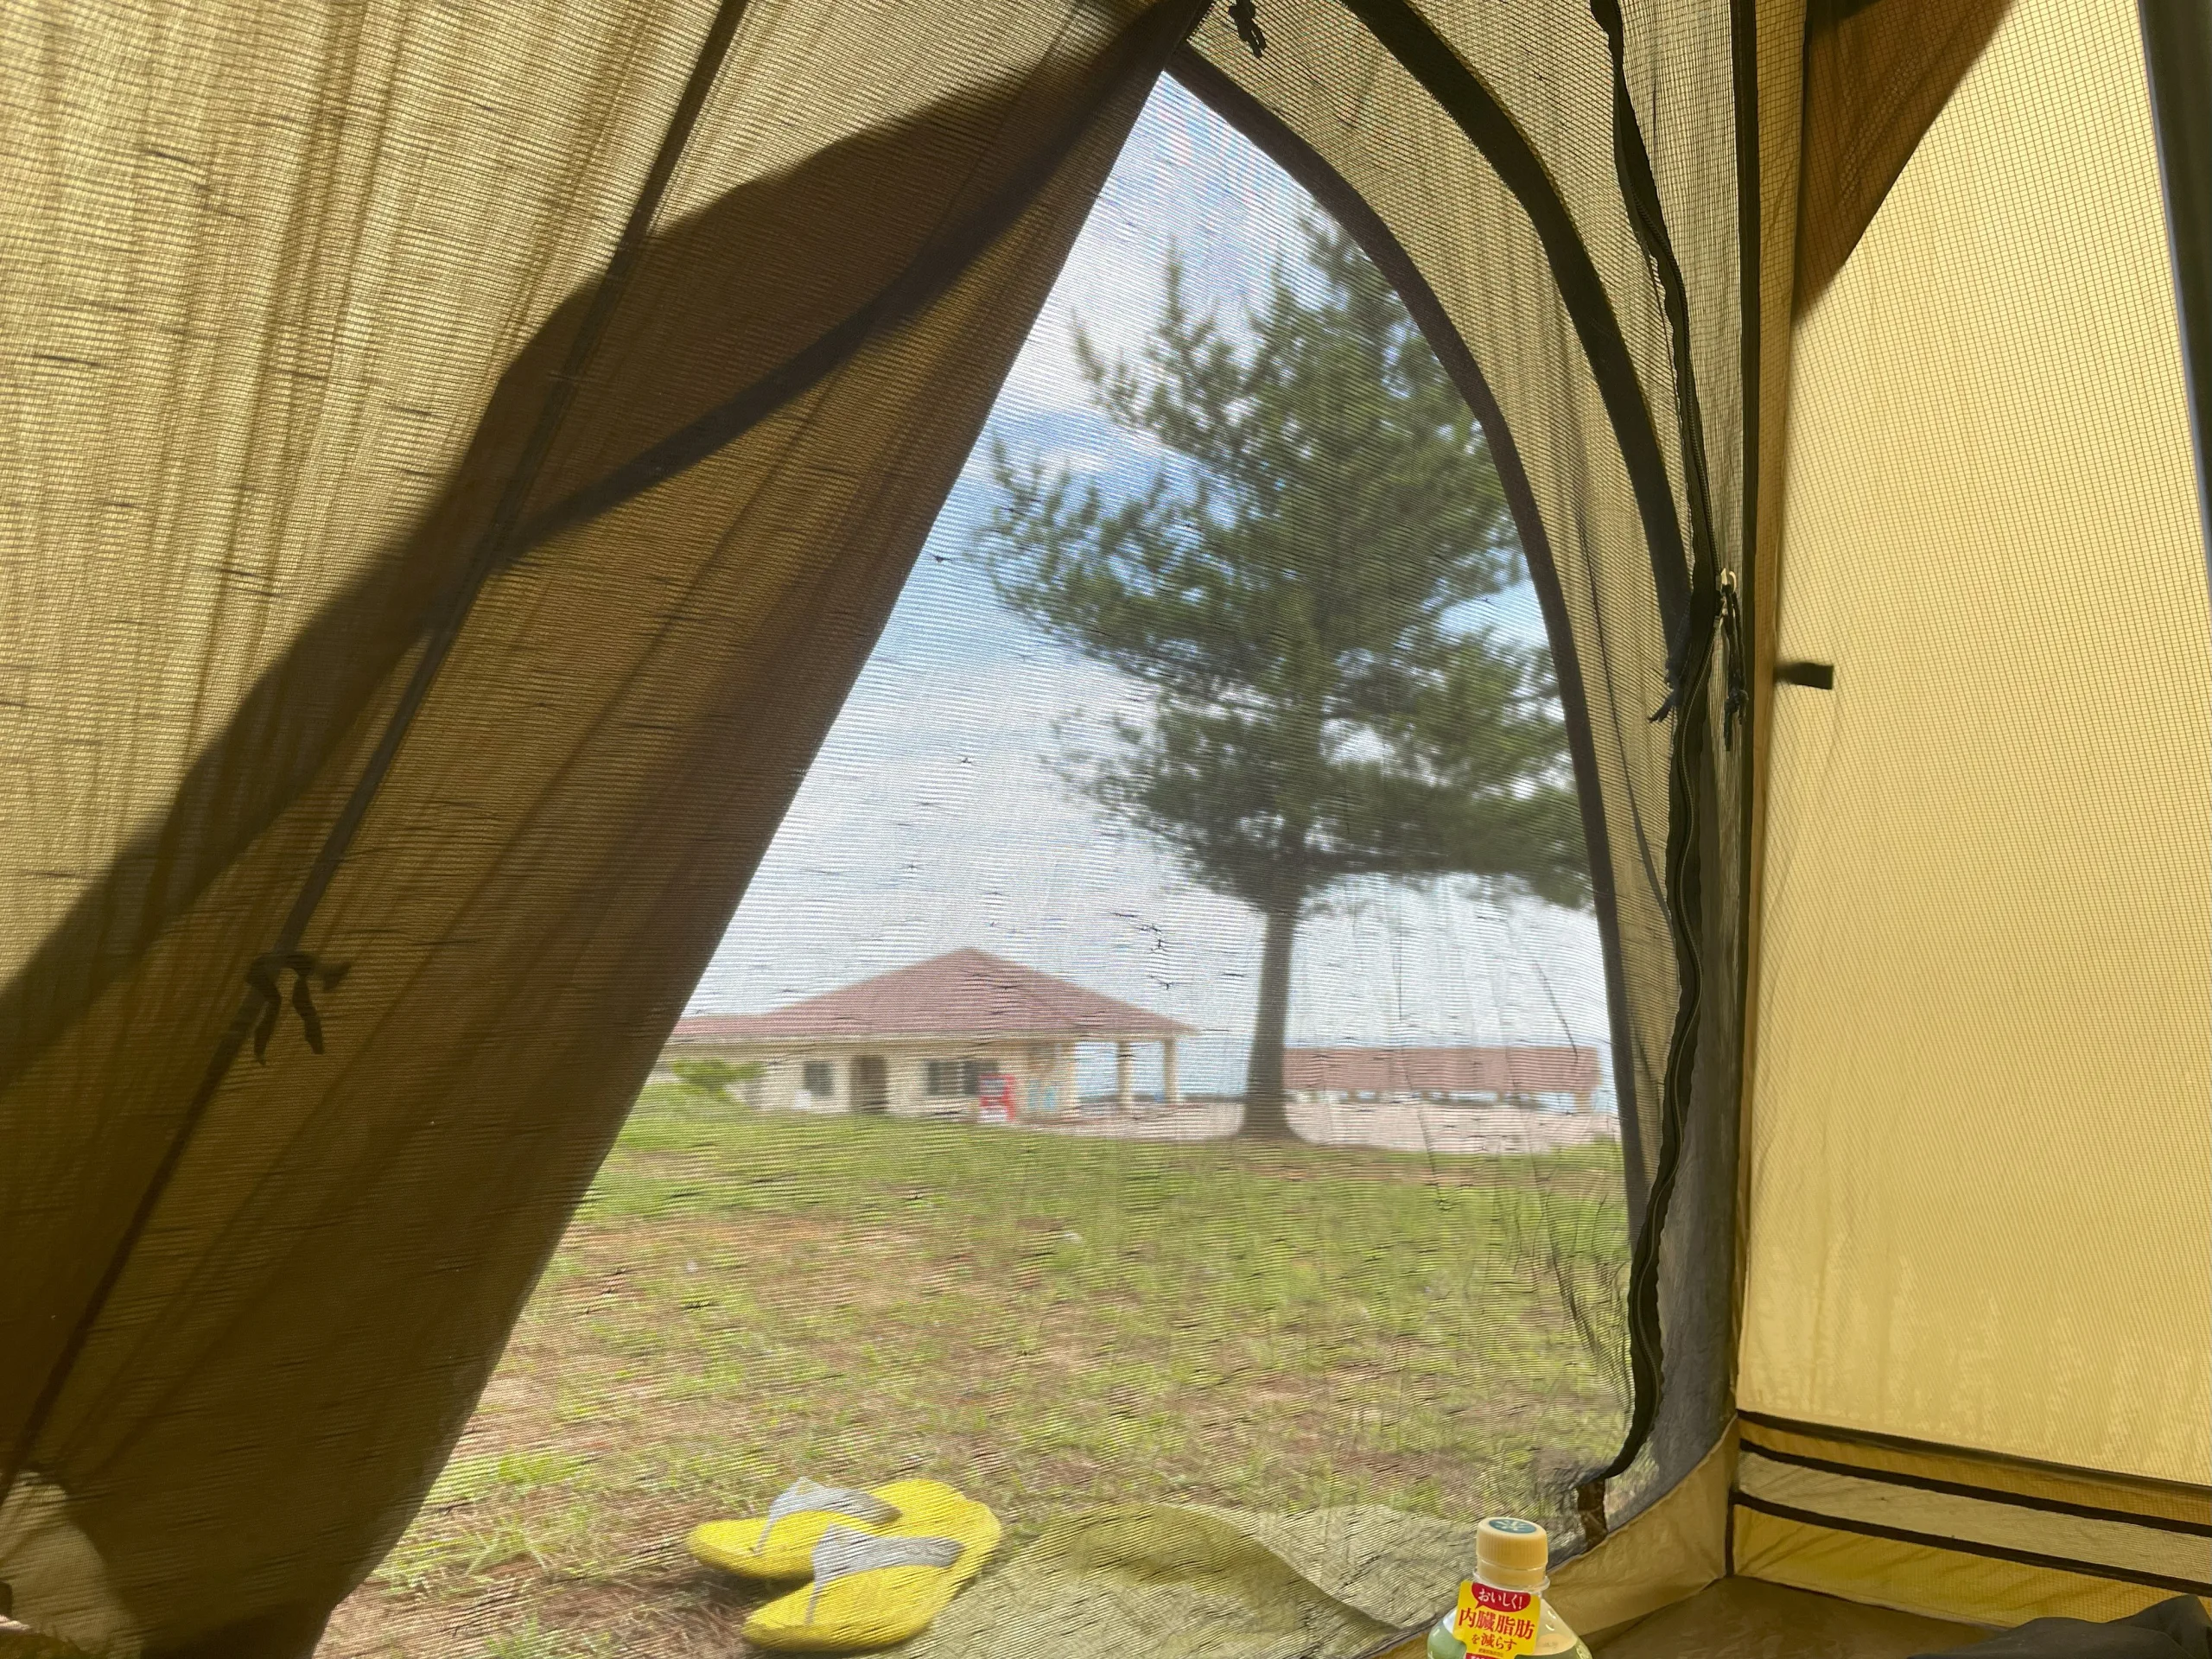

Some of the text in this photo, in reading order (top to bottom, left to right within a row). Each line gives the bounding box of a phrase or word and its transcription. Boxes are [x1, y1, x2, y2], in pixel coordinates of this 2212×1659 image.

[1478, 1589, 1522, 1610] おいしく!
[1459, 1607, 1535, 1639] 内臓脂肪
[1471, 1633, 1516, 1651] を減らす
